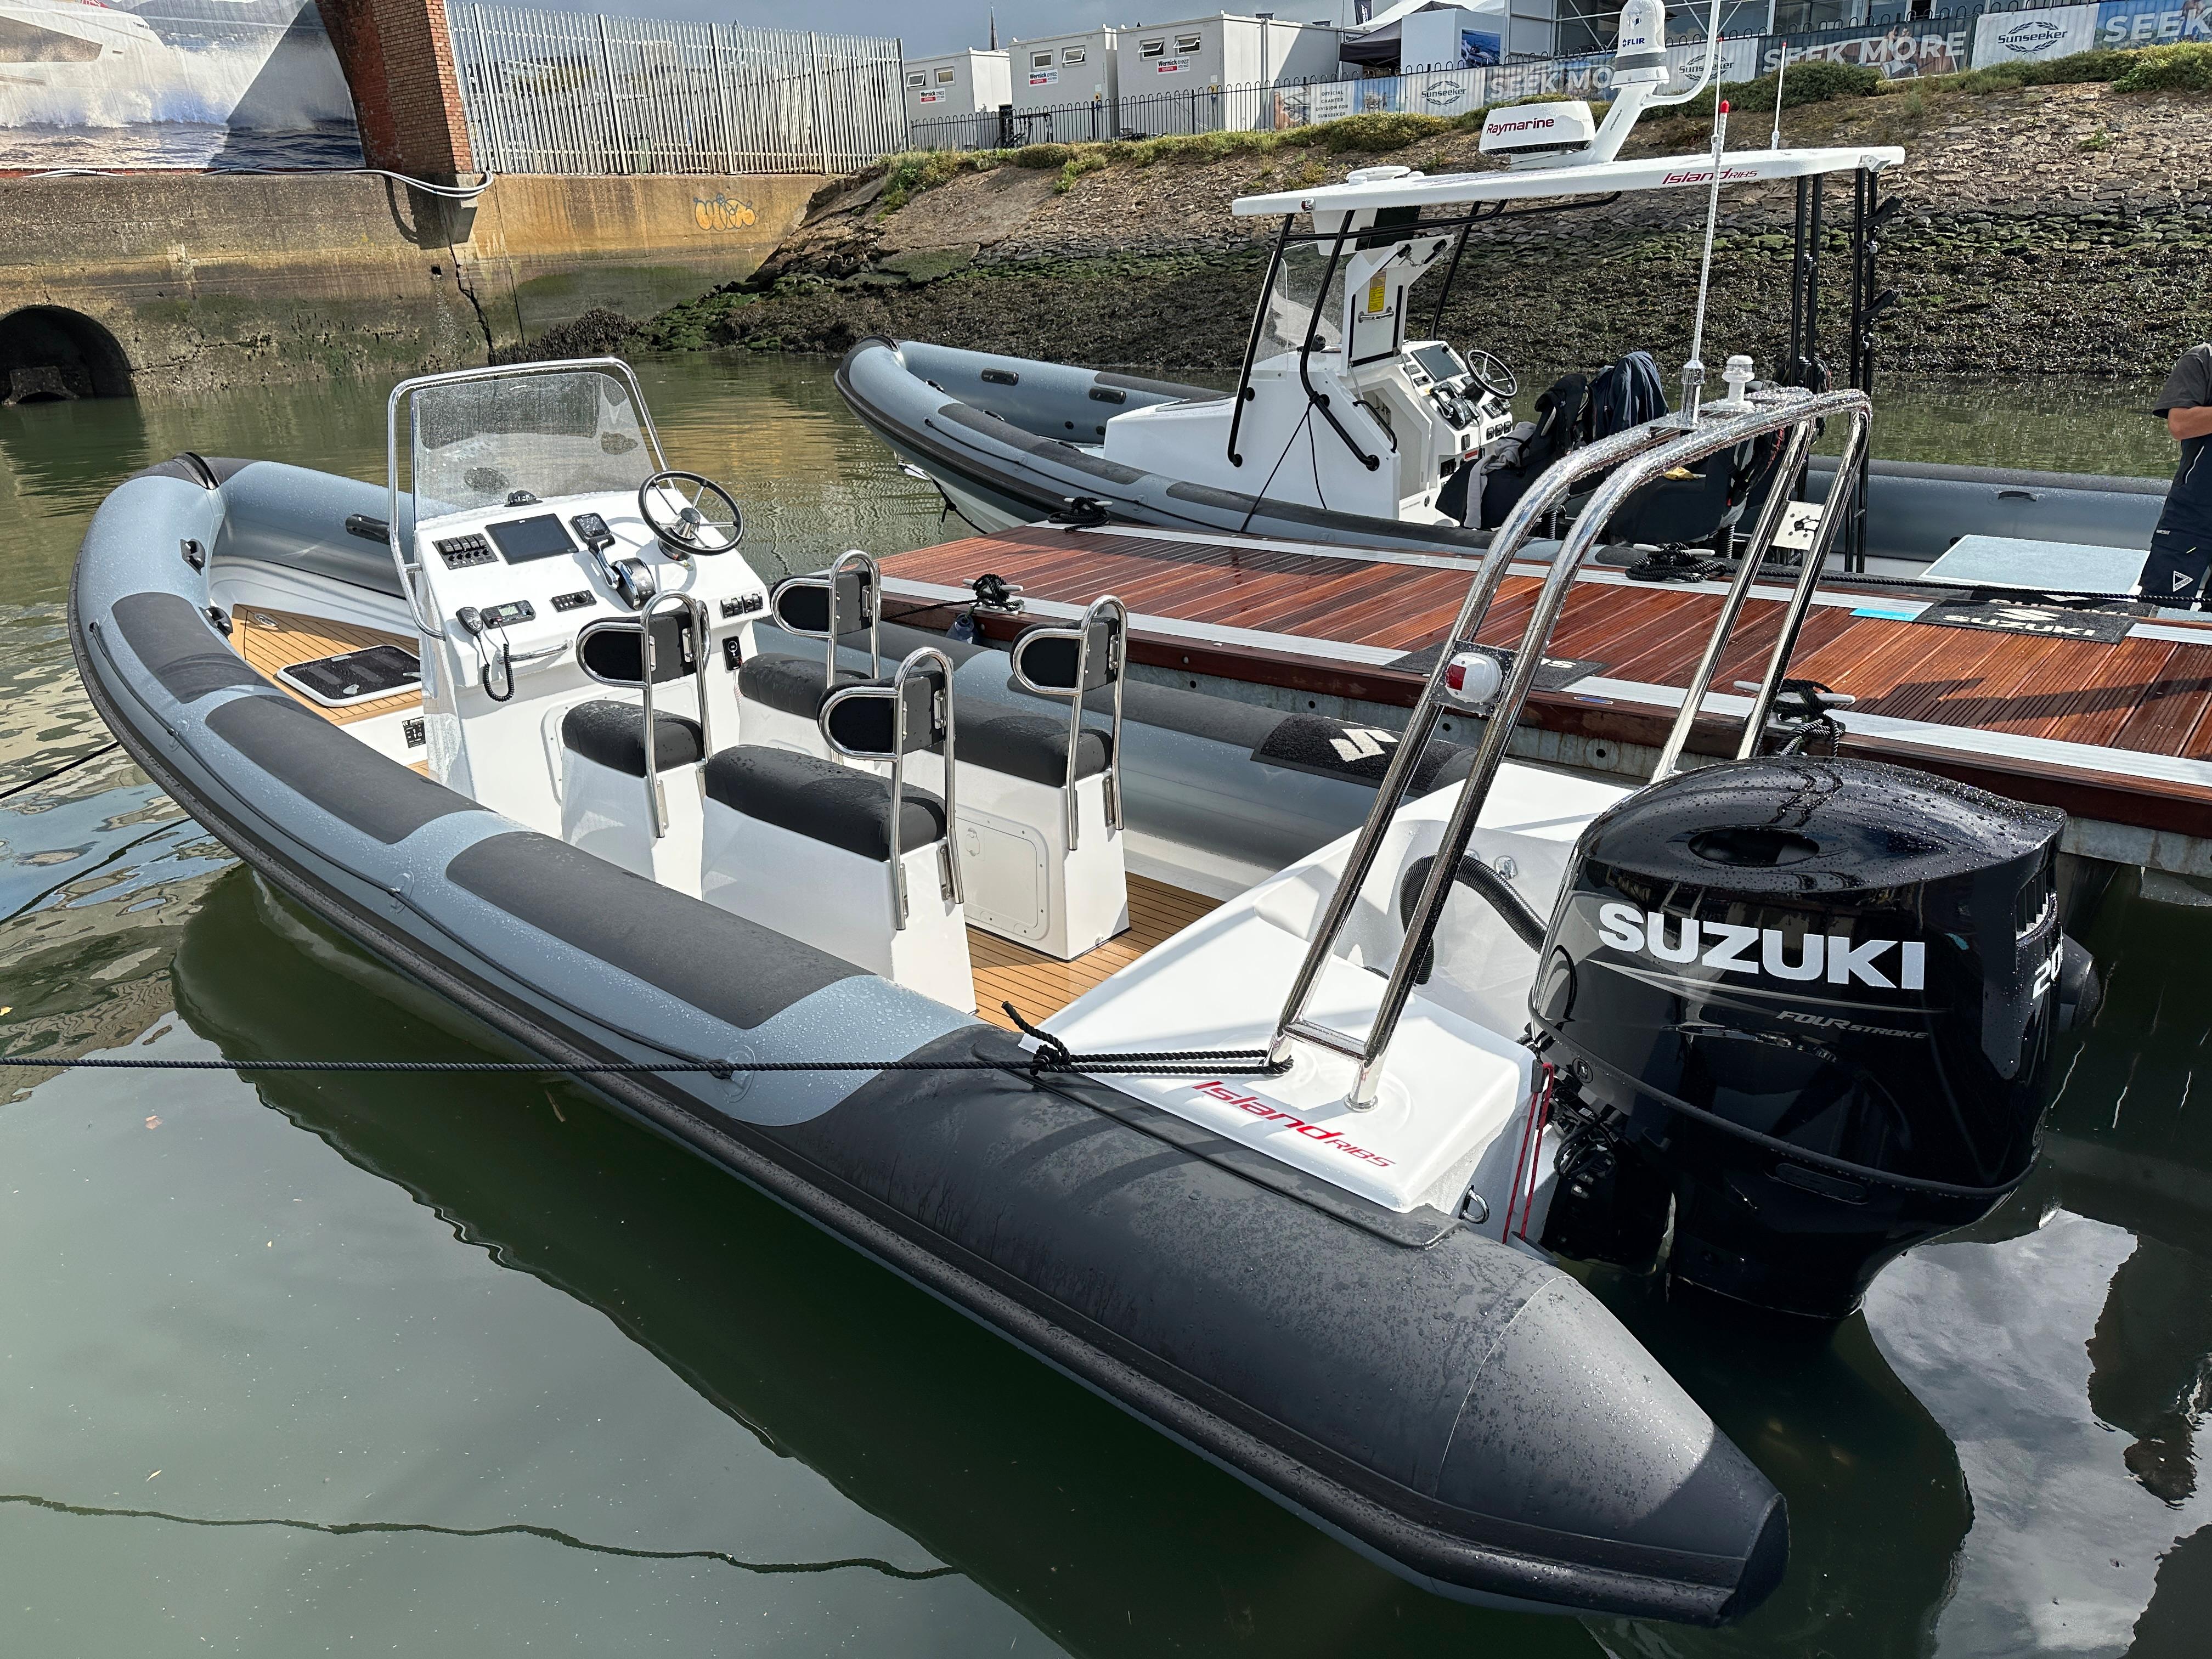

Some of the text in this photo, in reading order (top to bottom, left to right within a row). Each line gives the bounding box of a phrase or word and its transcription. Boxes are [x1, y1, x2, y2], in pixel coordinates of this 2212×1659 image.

[1998, 31, 2068, 44] Sunseeker
[2103, 7, 2212, 42] SEEK
[1864, 31, 1967, 62] MORE
[1421, 88, 1466, 98] Sunseeker
[1490, 71, 1559, 98] SEEK
[1486, 117, 1554, 136] Raymarine
[1943, 614, 2096, 637] SUZUKI
[1598, 902, 1925, 990] SUZUKI
[1776, 1010, 1929, 1039] FOUR STROKE
[1192, 1081, 1396, 1167] Island RIBS
